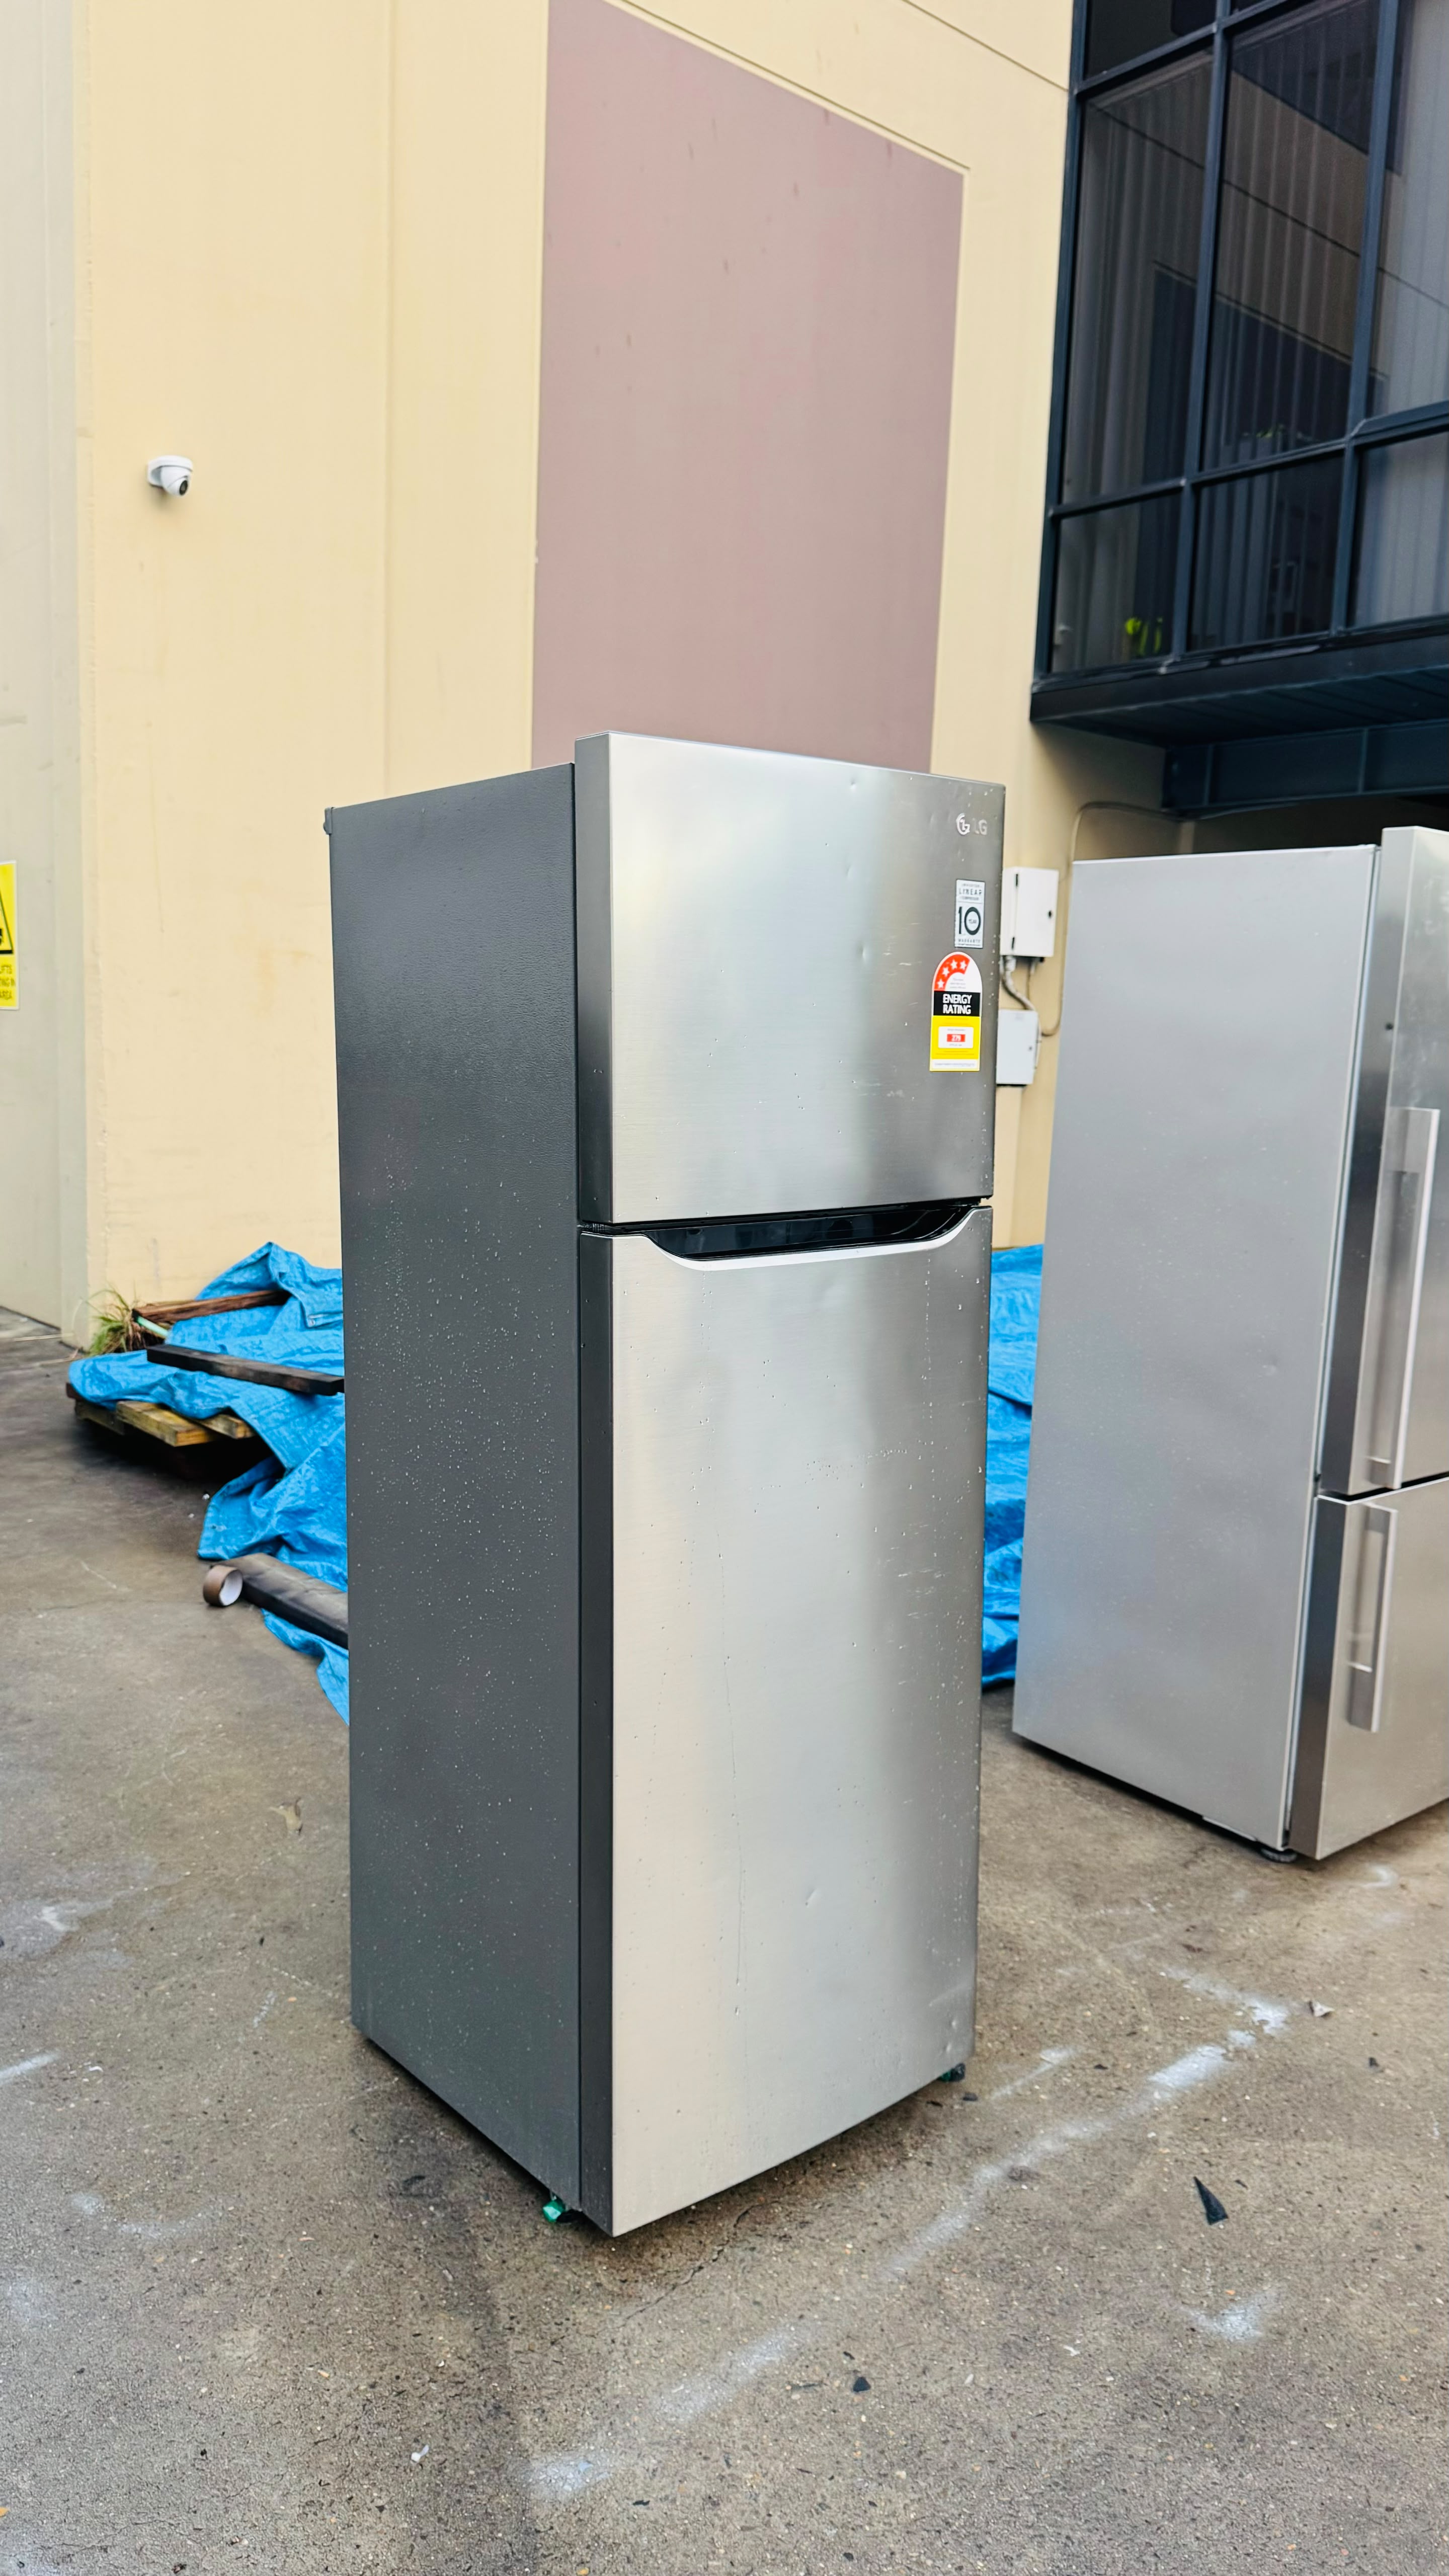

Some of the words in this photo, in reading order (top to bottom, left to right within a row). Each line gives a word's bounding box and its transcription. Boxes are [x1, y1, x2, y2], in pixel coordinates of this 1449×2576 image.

[974, 819, 988, 835] LG
[958, 906, 981, 935] 10
[943, 994, 972, 1004] ENERGY
[943, 1004, 972, 1015] RATING
